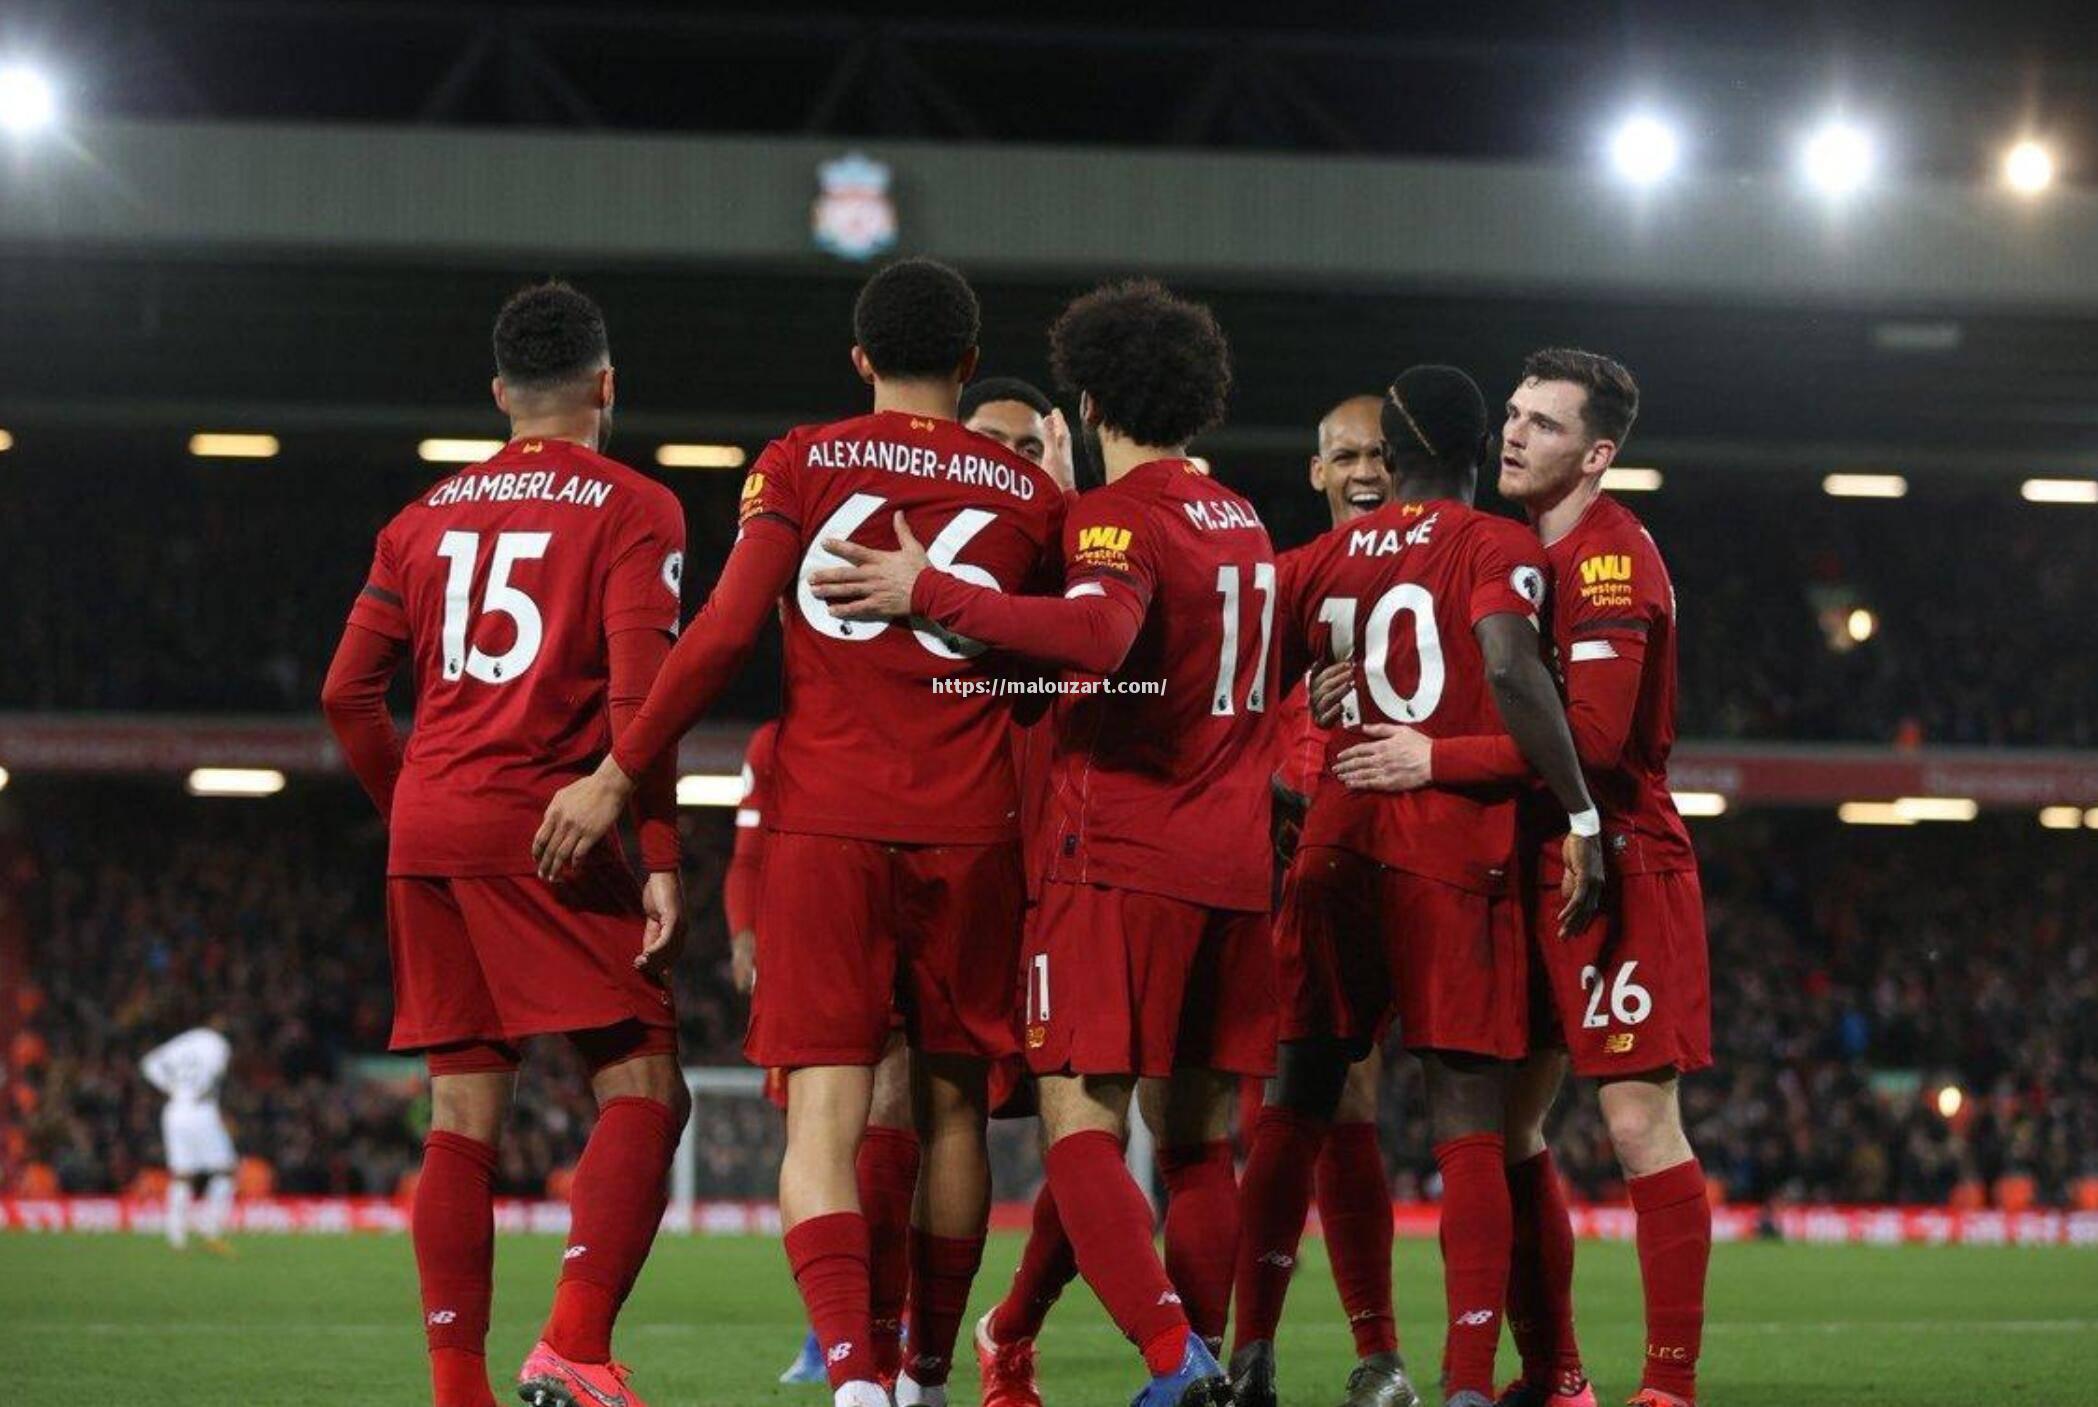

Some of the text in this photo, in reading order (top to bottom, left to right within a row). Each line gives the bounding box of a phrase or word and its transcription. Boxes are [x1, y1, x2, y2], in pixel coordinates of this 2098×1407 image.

[428, 471, 613, 508] CHAMBERLAIN
[806, 440, 1035, 501] ALEXANDER-ARNOLD
[1079, 526, 1133, 551] WU
[1183, 499, 1265, 531] M.SAL
[1580, 555, 1632, 584] WU
[437, 530, 552, 684] 15
[1212, 562, 1276, 716] 11
[1318, 583, 1446, 730] 10
[1026, 953, 1049, 1025] 1
[1580, 960, 1652, 1028] 26
